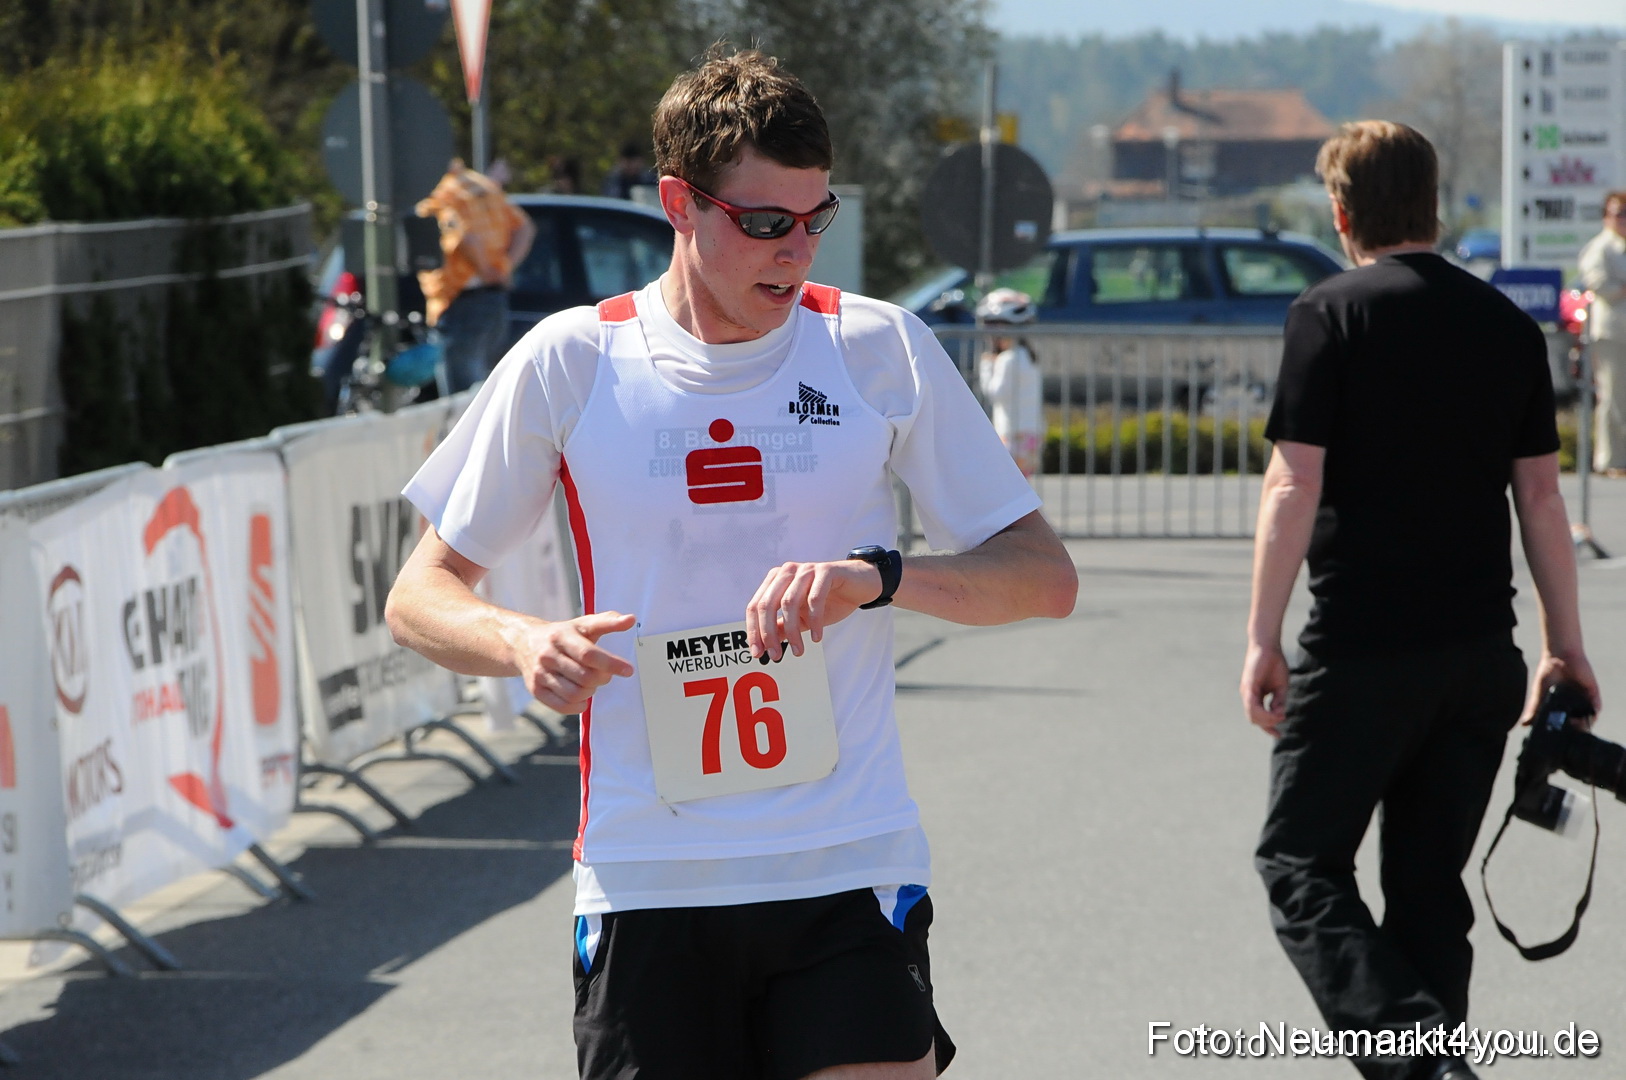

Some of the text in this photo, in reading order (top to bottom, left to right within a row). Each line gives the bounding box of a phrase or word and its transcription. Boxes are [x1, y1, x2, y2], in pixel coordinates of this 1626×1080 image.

[788, 401, 840, 417] BLOEMEN
[810, 416, 841, 427] Collection
[685, 428, 807, 450] Behinger
[666, 630, 749, 661] MEYER
[668, 651, 752, 675] WERBUNG
[683, 671, 787, 775] 76
